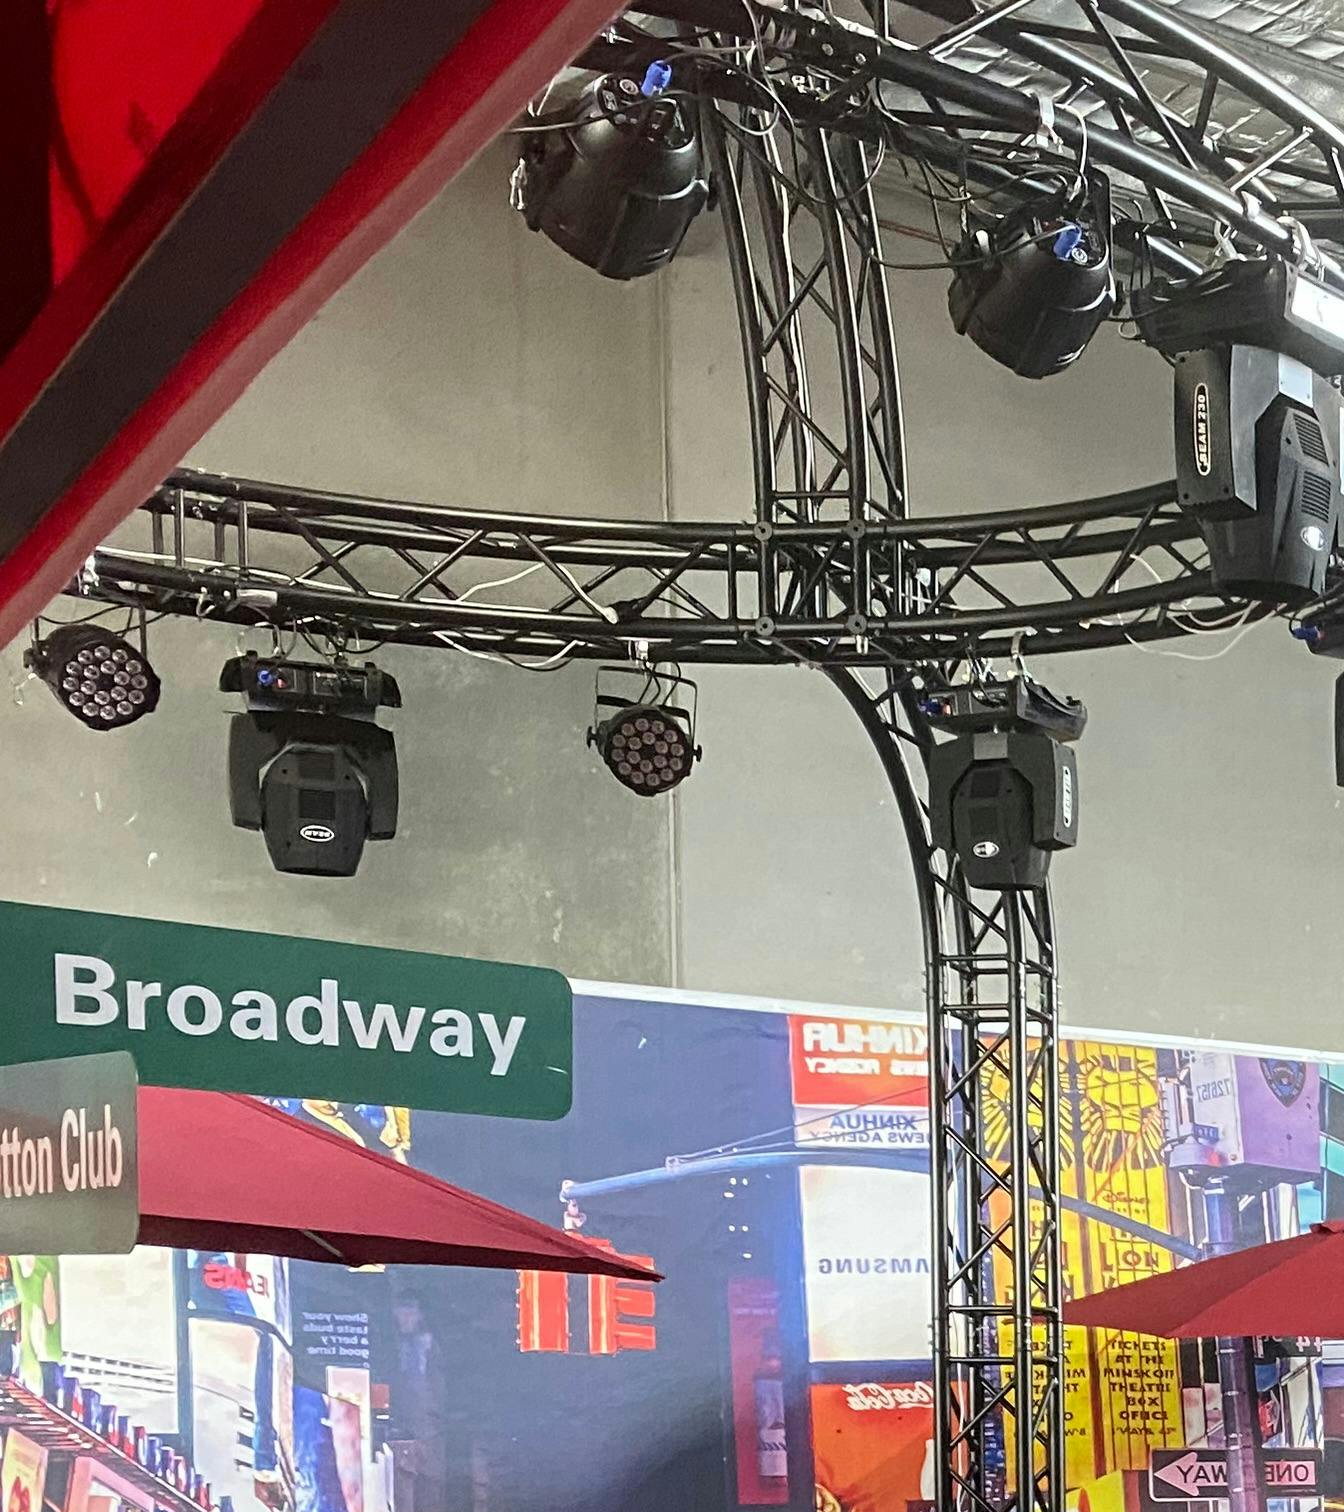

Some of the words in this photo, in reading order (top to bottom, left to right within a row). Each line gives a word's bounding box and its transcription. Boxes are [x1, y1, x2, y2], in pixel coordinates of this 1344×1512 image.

[1198, 394, 1207, 420] 230
[1198, 423, 1208, 464] BEAM
[54, 953, 526, 1075] Broadway
[60, 1104, 122, 1192] Club
